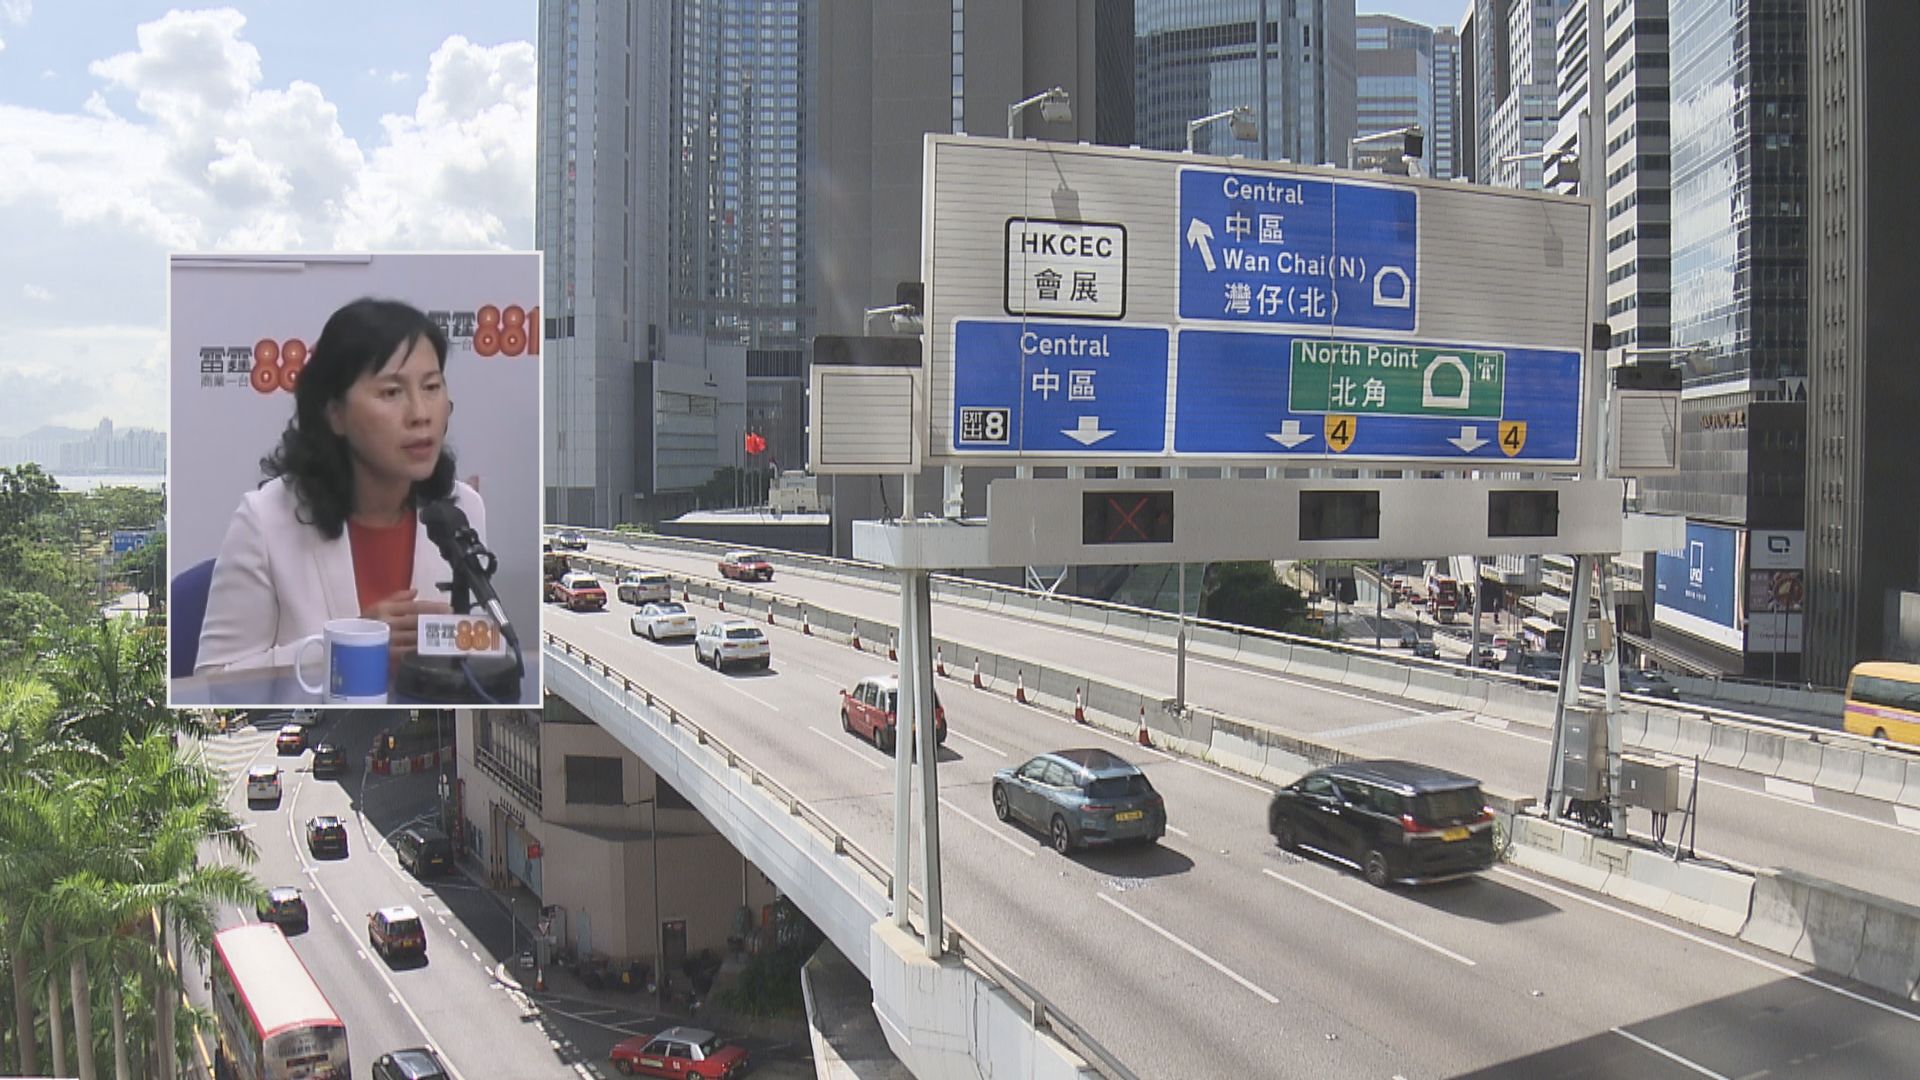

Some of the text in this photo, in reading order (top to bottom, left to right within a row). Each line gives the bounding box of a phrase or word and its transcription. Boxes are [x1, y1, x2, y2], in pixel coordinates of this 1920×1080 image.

[1223, 176, 1304, 206] Central
[1225, 210, 1284, 245] 中區
[1021, 232, 1112, 258] HKCEC
[1222, 247, 1366, 284] Wan Chai(N)
[1033, 268, 1098, 303] 會展
[1223, 282, 1339, 318] 灣仔(北)
[1020, 331, 1110, 357] Central
[1301, 341, 1419, 369] North Point
[1031, 367, 1097, 401] 中區
[1331, 375, 1386, 408] 北角
[963, 411, 983, 424] EXIT
[985, 412, 1004, 440] 8
[963, 424, 983, 440] 出
[1330, 419, 1349, 446] 4
[1503, 425, 1520, 450] 4
